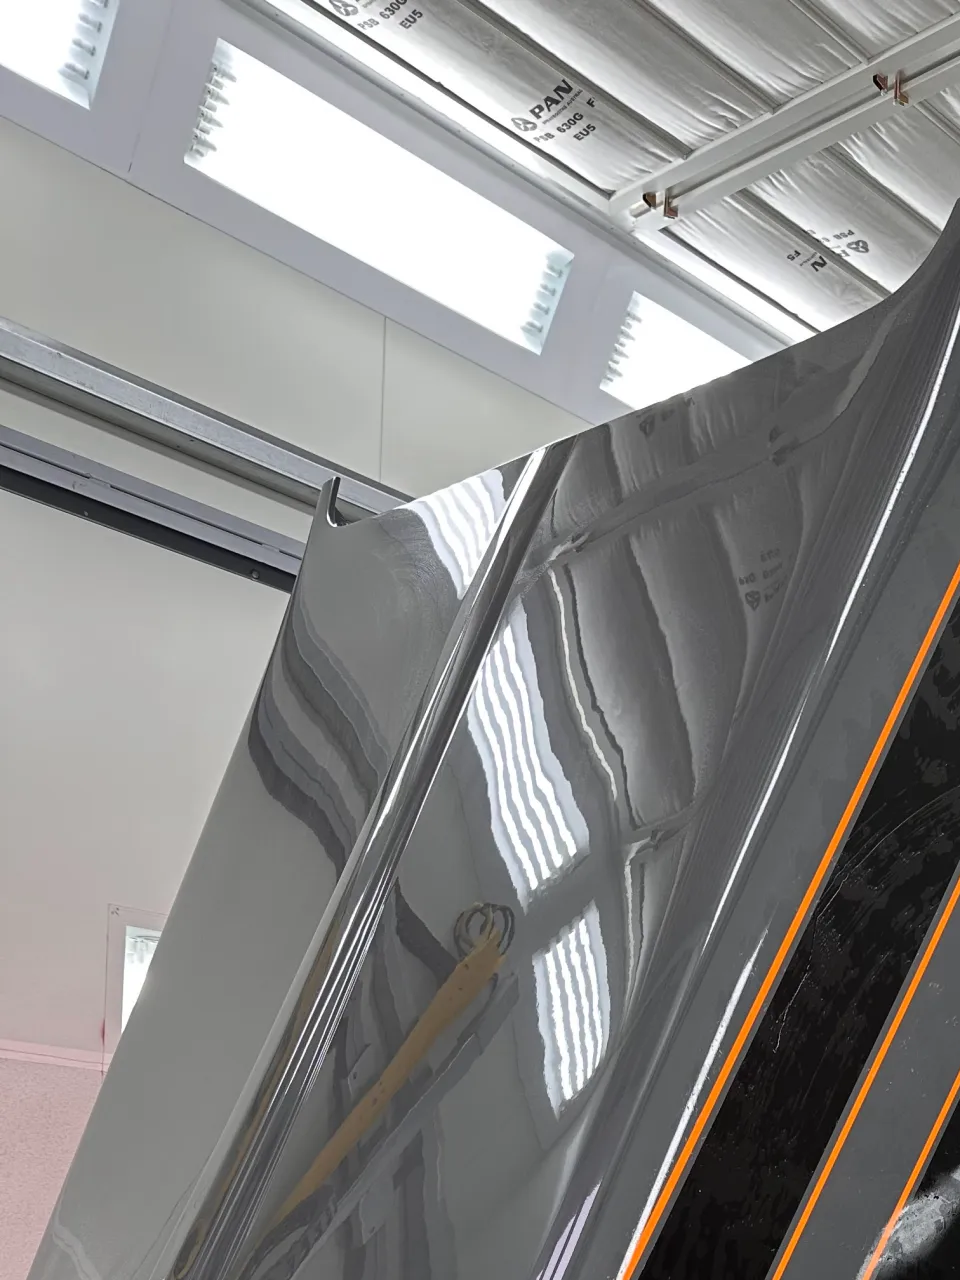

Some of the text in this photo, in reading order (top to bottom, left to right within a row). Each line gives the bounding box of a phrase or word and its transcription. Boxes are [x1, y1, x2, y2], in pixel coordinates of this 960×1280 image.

[399, 9, 424, 30] EU5
[529, 79, 574, 120] PAN
[556, 112, 584, 133] 630G
[573, 123, 597, 141] EU5
[786, 249, 802, 262] F5
